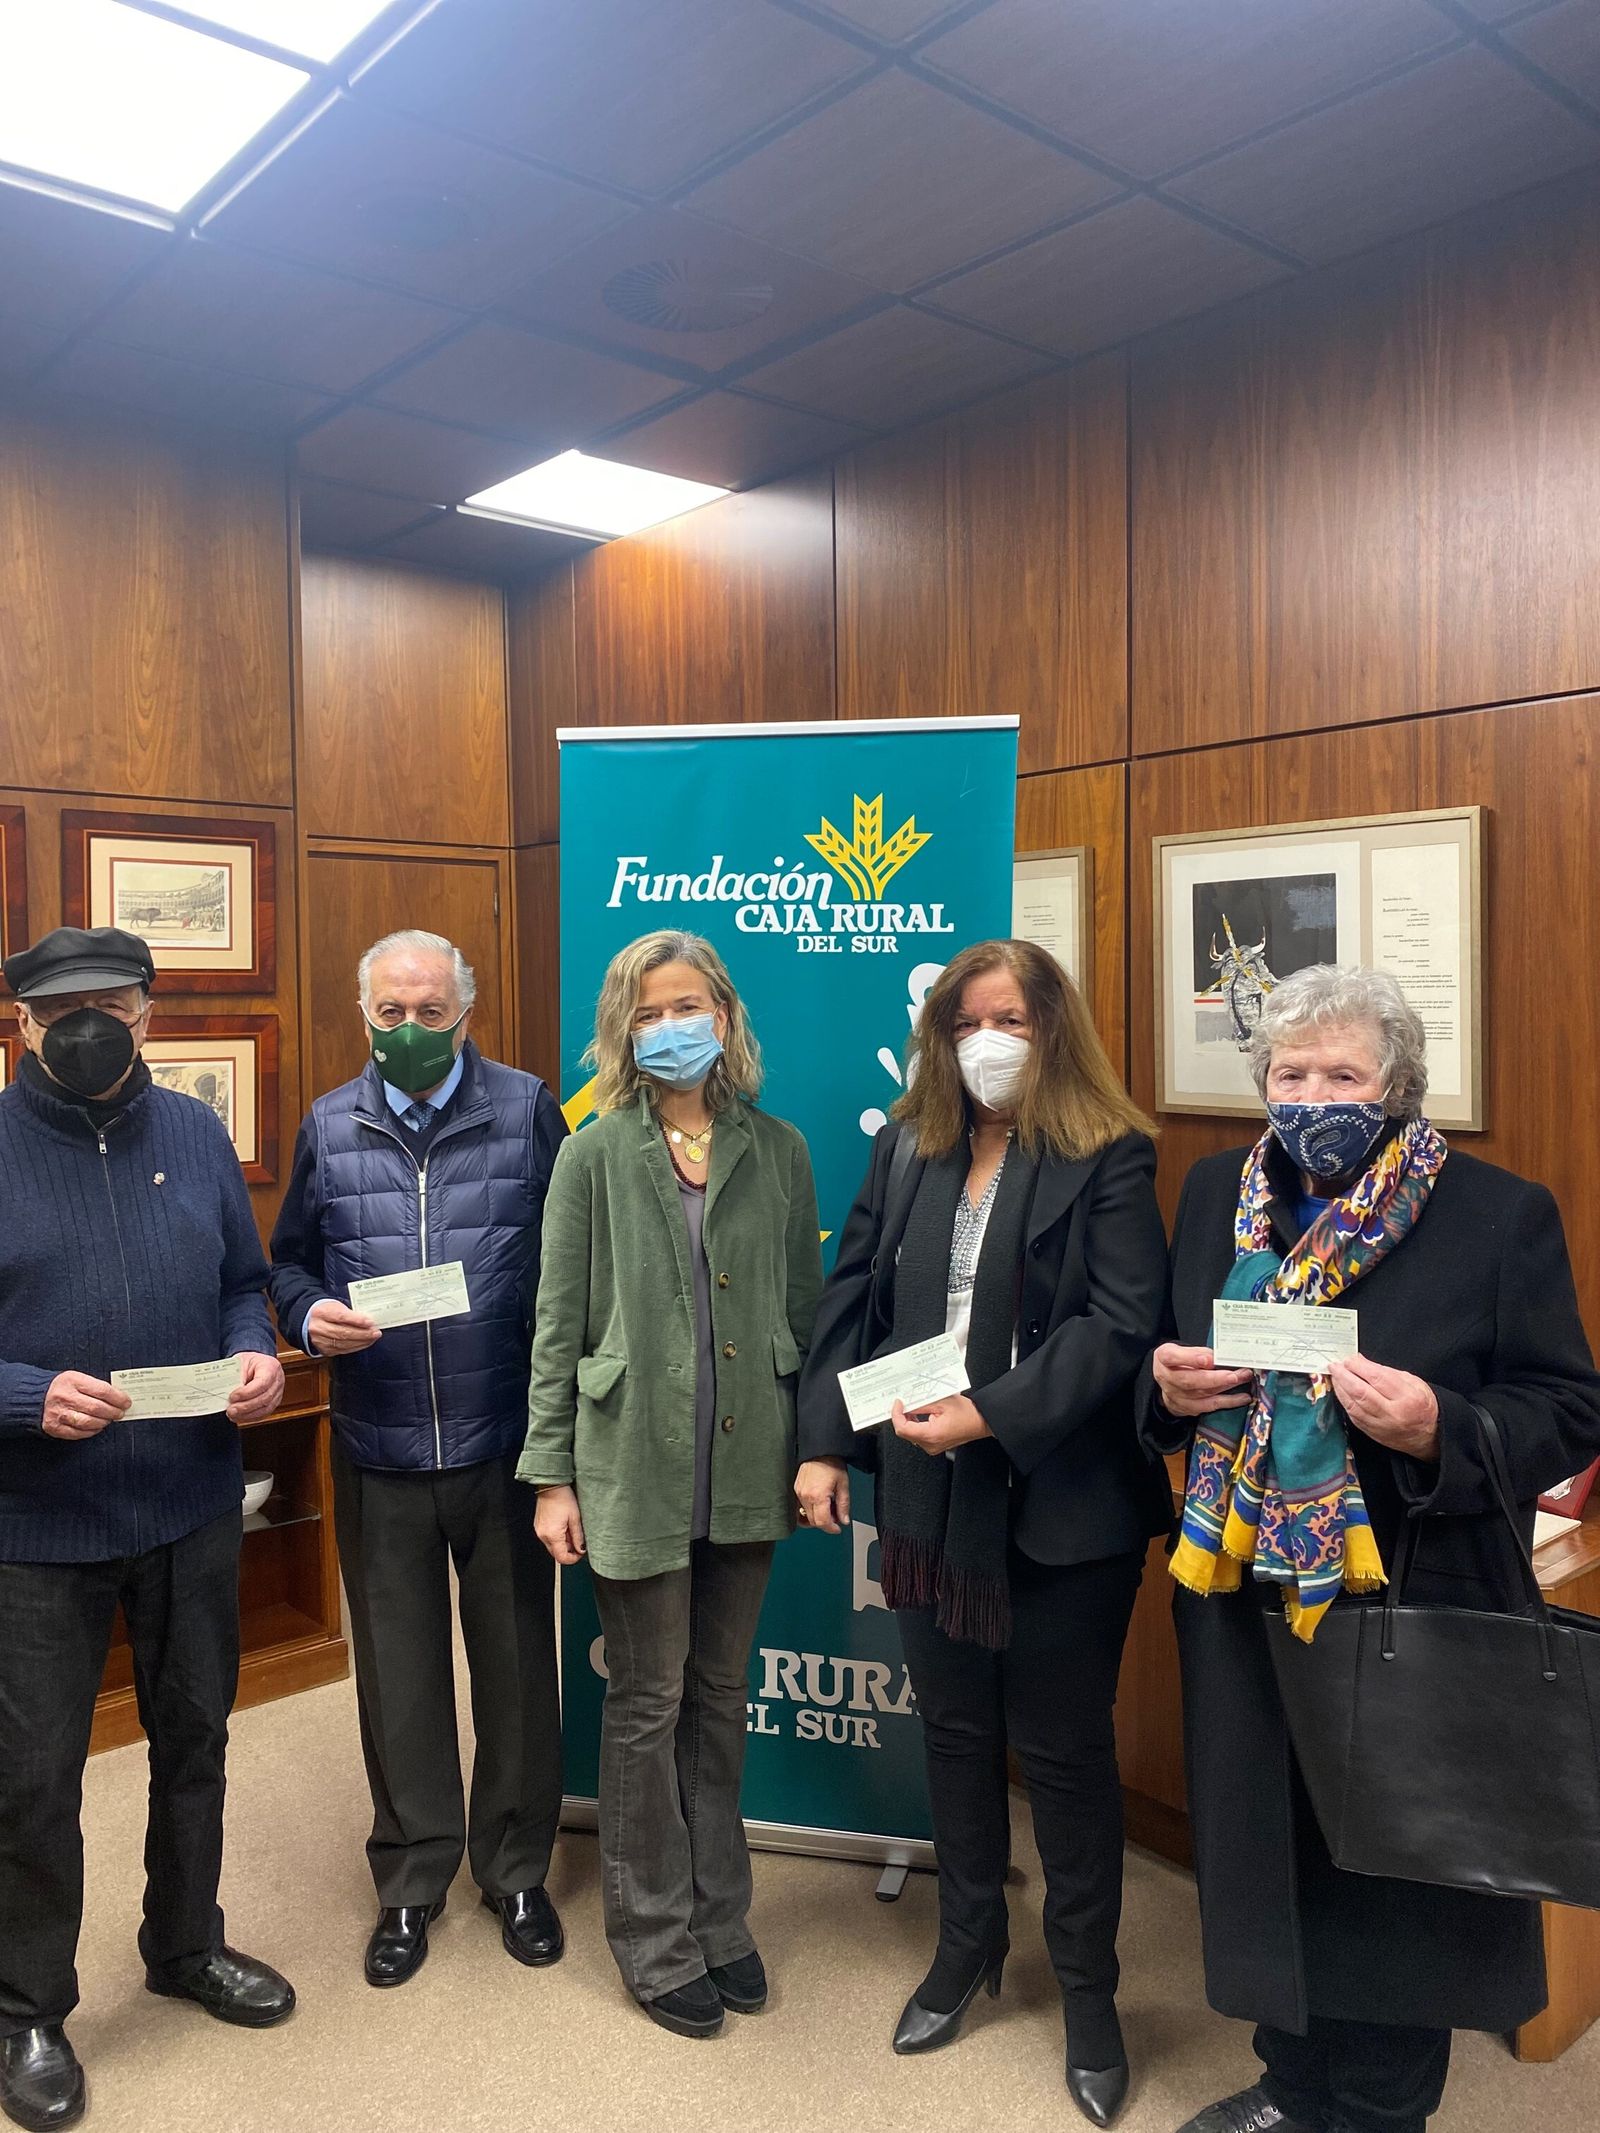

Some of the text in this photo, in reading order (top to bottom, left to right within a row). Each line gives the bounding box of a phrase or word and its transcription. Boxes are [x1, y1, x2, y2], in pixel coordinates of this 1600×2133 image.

[606, 855, 833, 908] Fundación
[735, 903, 954, 935] CAJA RURAL
[796, 935, 899, 953] DEL SUR
[758, 1648, 921, 1716] RURA
[796, 1709, 881, 1748] SUR
